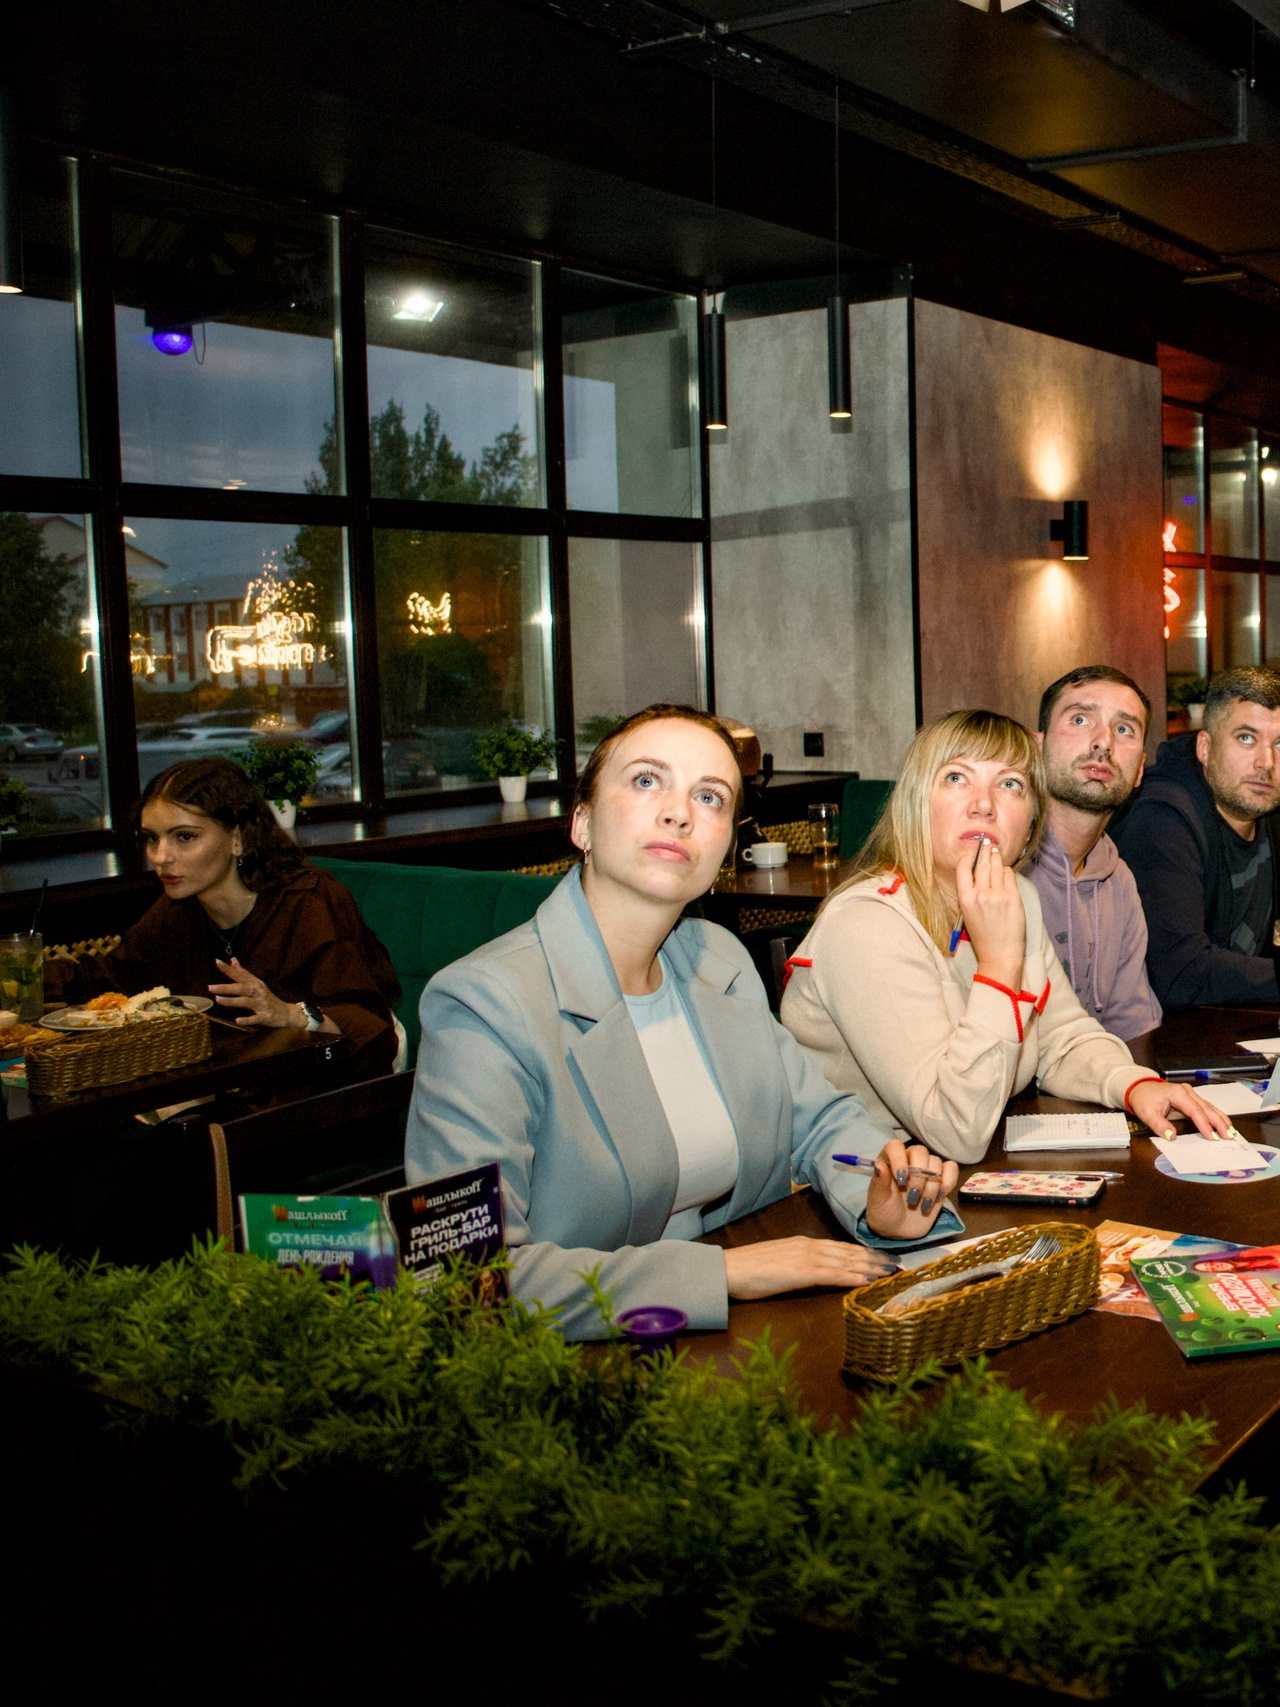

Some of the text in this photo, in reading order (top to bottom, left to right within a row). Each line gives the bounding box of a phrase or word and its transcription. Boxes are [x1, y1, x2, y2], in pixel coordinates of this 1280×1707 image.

[325, 1047, 332, 1060] 5
[409, 1215, 492, 1252] ГРИЛЬ-БАР
[410, 1203, 489, 1240] РАСКРУТИ
[277, 1248, 355, 1266] ДЕНЬ РОЖДЕНИЯ
[403, 1224, 499, 1267] НА ПОДАРКИ
